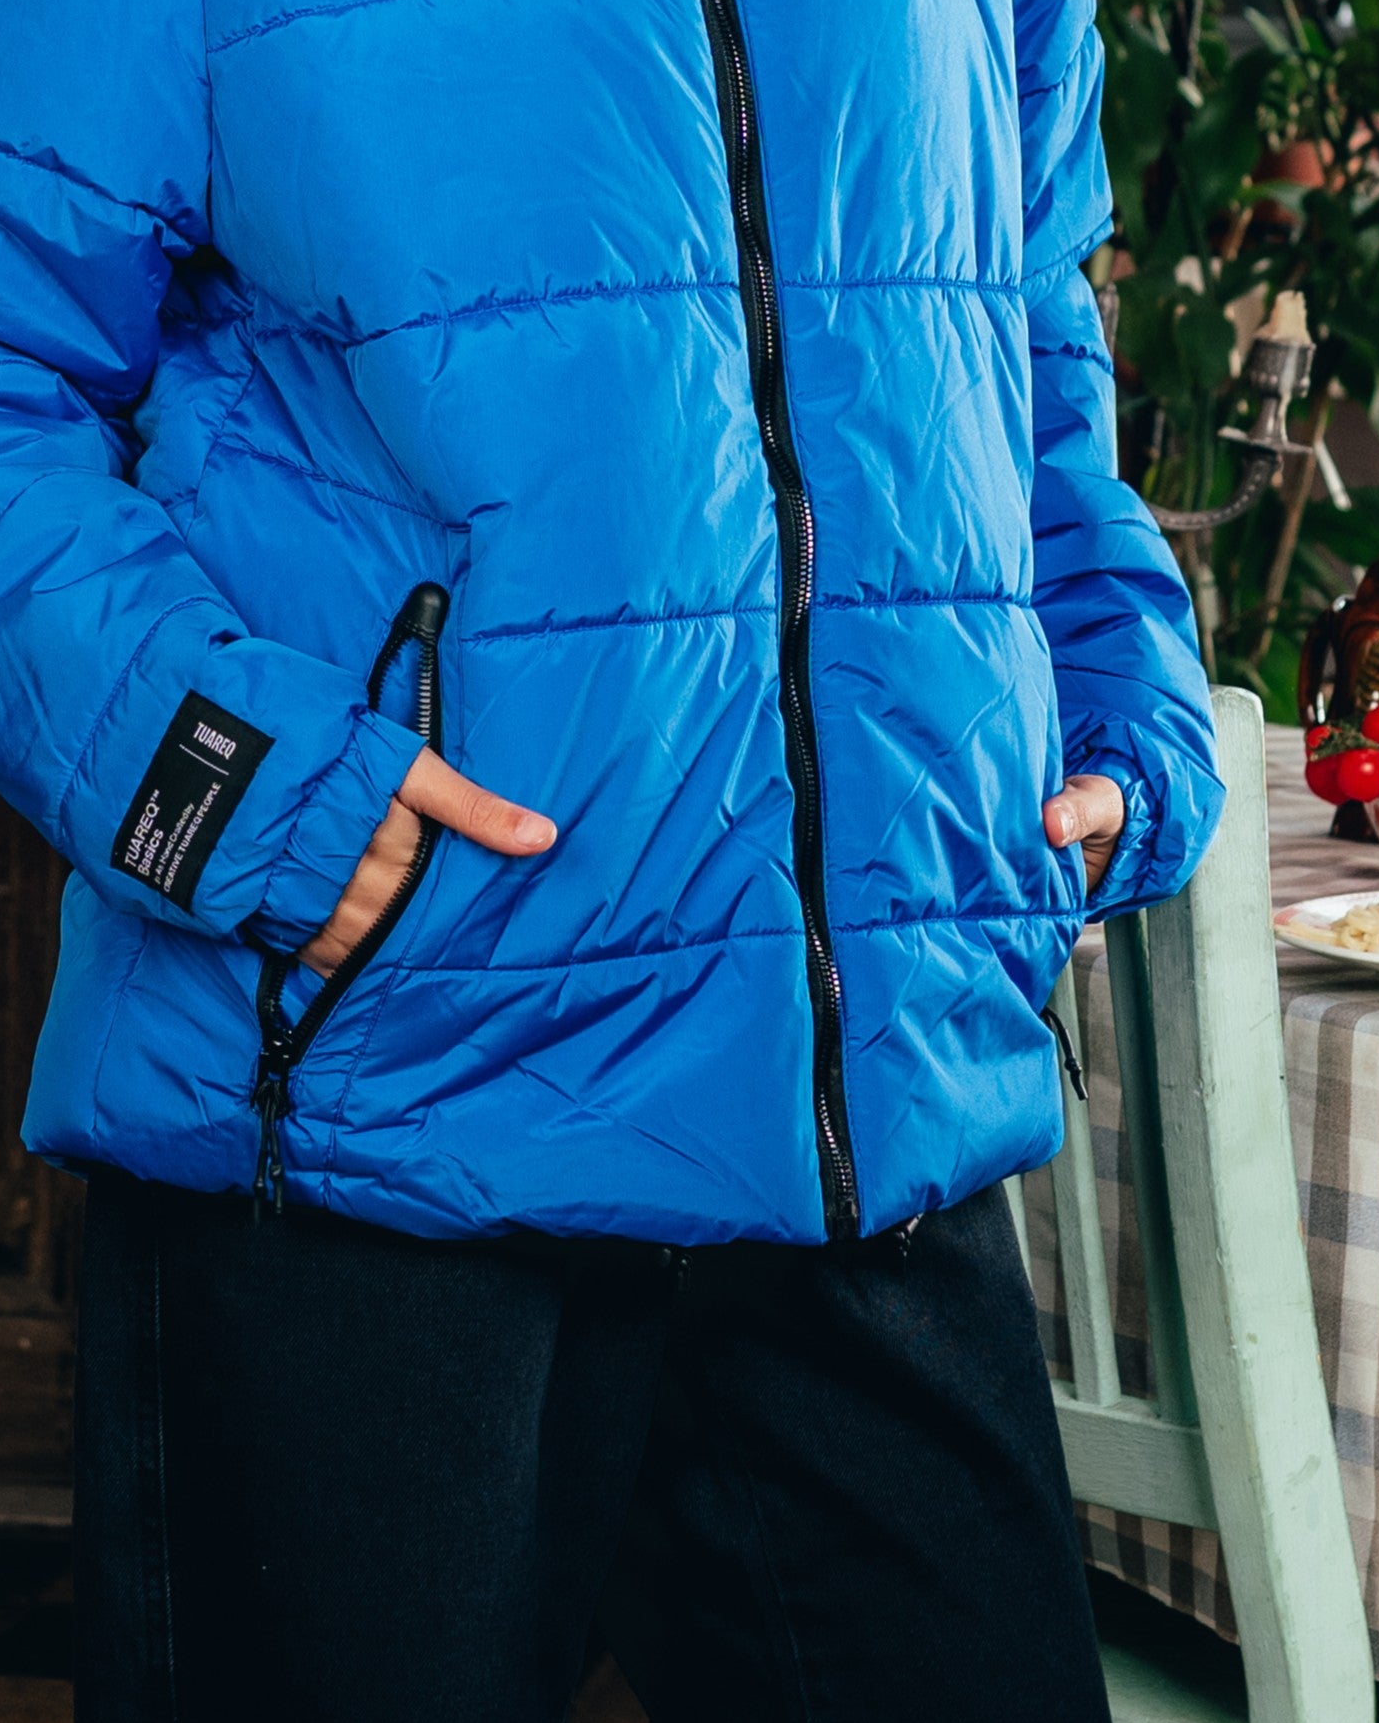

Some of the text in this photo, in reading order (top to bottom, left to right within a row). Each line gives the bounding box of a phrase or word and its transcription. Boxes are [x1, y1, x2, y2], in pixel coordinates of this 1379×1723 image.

[193, 721, 237, 761] TUAREQ
[138, 829, 164, 877] Basics
[163, 780, 221, 893] CREATIVE TUAREQ PEOPLE
